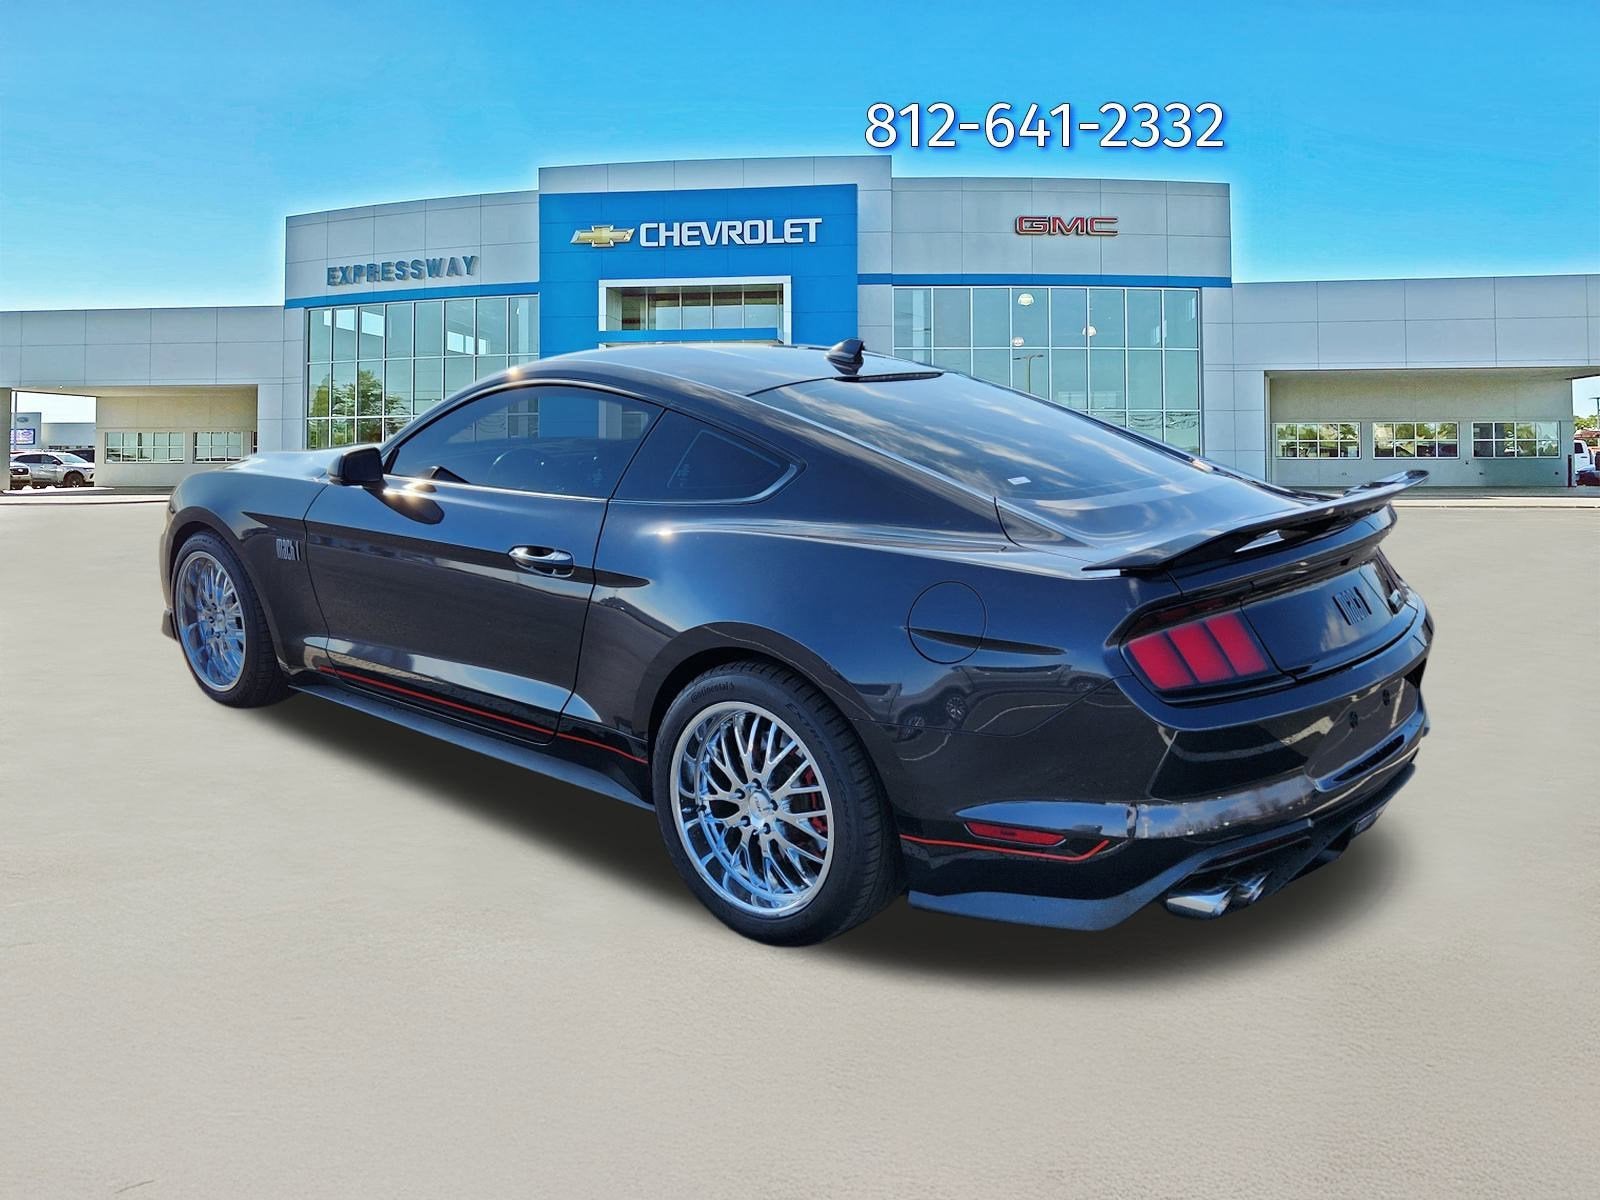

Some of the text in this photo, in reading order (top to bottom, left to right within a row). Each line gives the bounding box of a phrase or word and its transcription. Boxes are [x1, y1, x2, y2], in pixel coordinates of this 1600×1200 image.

[639, 217, 823, 248] CHEVROLET
[1014, 215, 1118, 236] GMC
[327, 255, 478, 286] EXPRESSWAY
